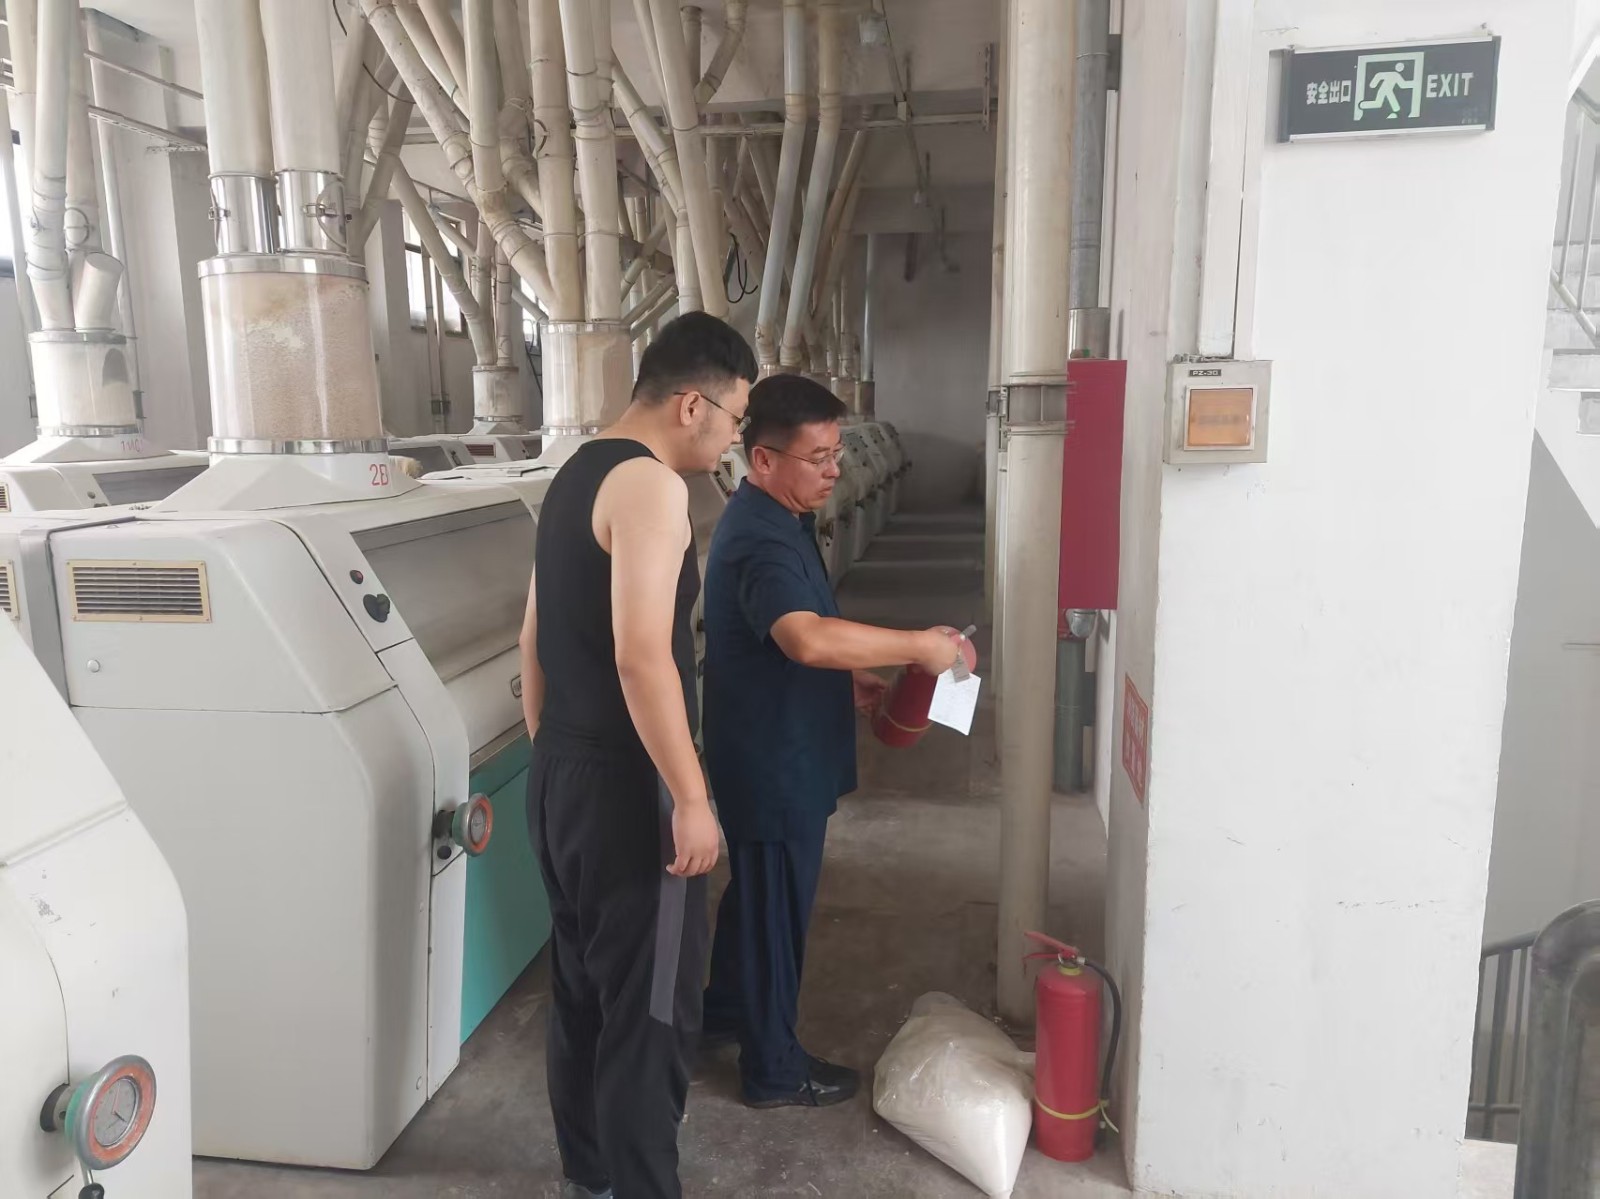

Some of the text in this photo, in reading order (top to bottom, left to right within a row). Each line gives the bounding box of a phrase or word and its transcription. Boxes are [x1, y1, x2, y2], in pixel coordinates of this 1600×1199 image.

[1306, 80, 1351, 105] 安全出口
[1426, 72, 1474, 98] EXIT
[369, 463, 389, 486] 2B
